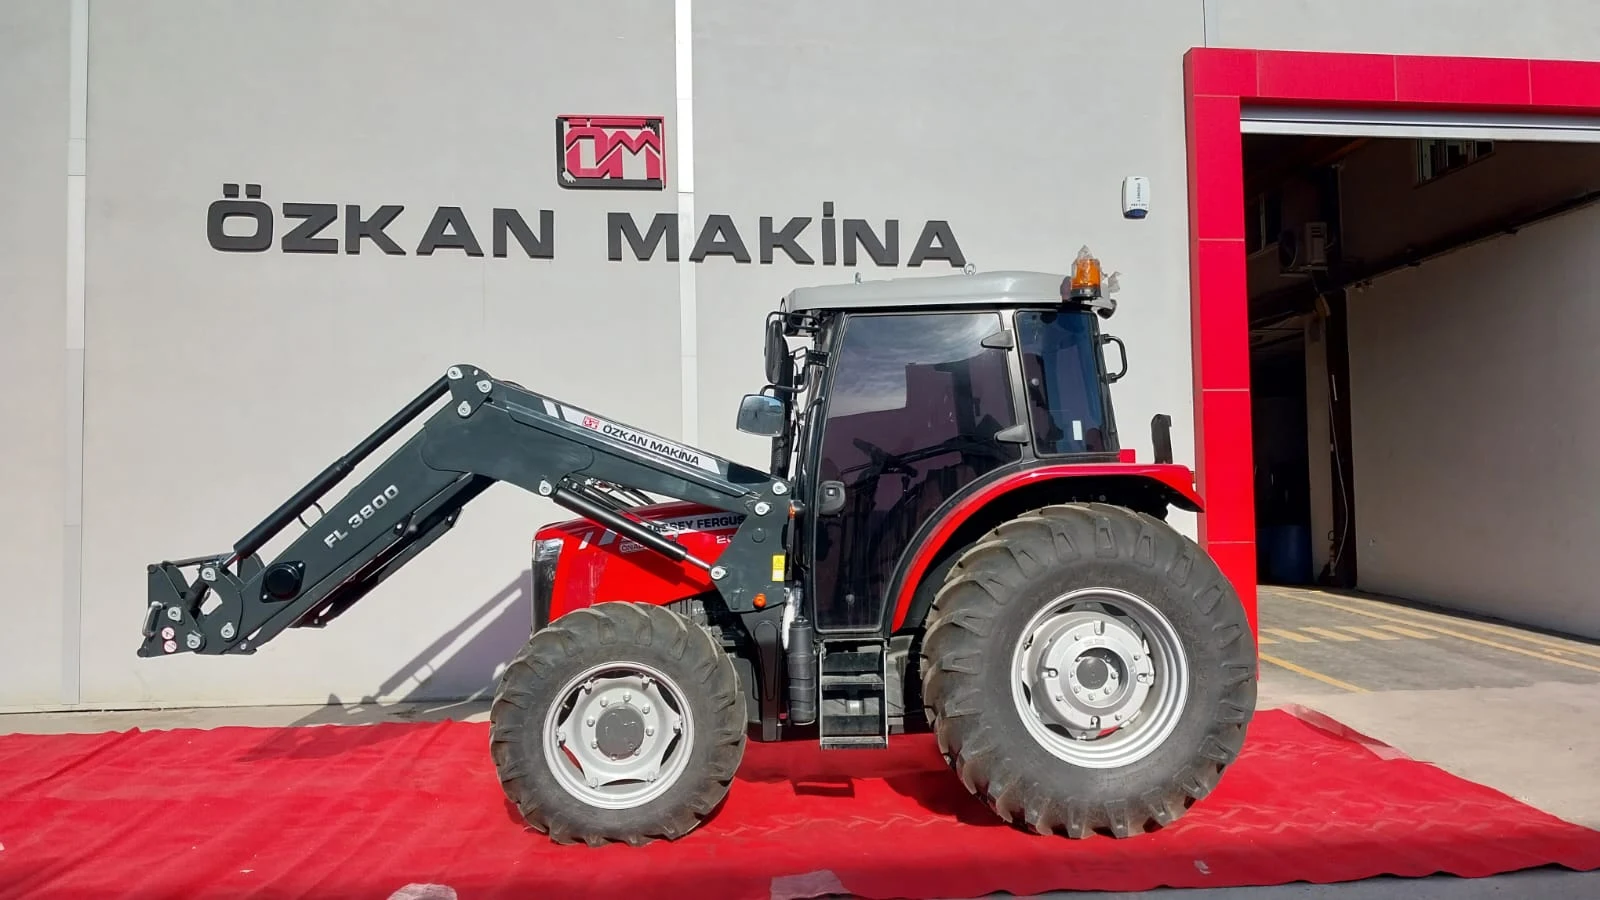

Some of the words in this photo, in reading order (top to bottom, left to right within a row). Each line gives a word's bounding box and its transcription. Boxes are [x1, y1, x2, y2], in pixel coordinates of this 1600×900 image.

[206, 183, 554, 259] ÖZKAN
[607, 201, 967, 268] MAKİNA
[602, 424, 648, 446] ÖZKAN
[649, 441, 699, 465] MAKİNA
[323, 529, 348, 548] FL
[348, 484, 399, 529] 3800
